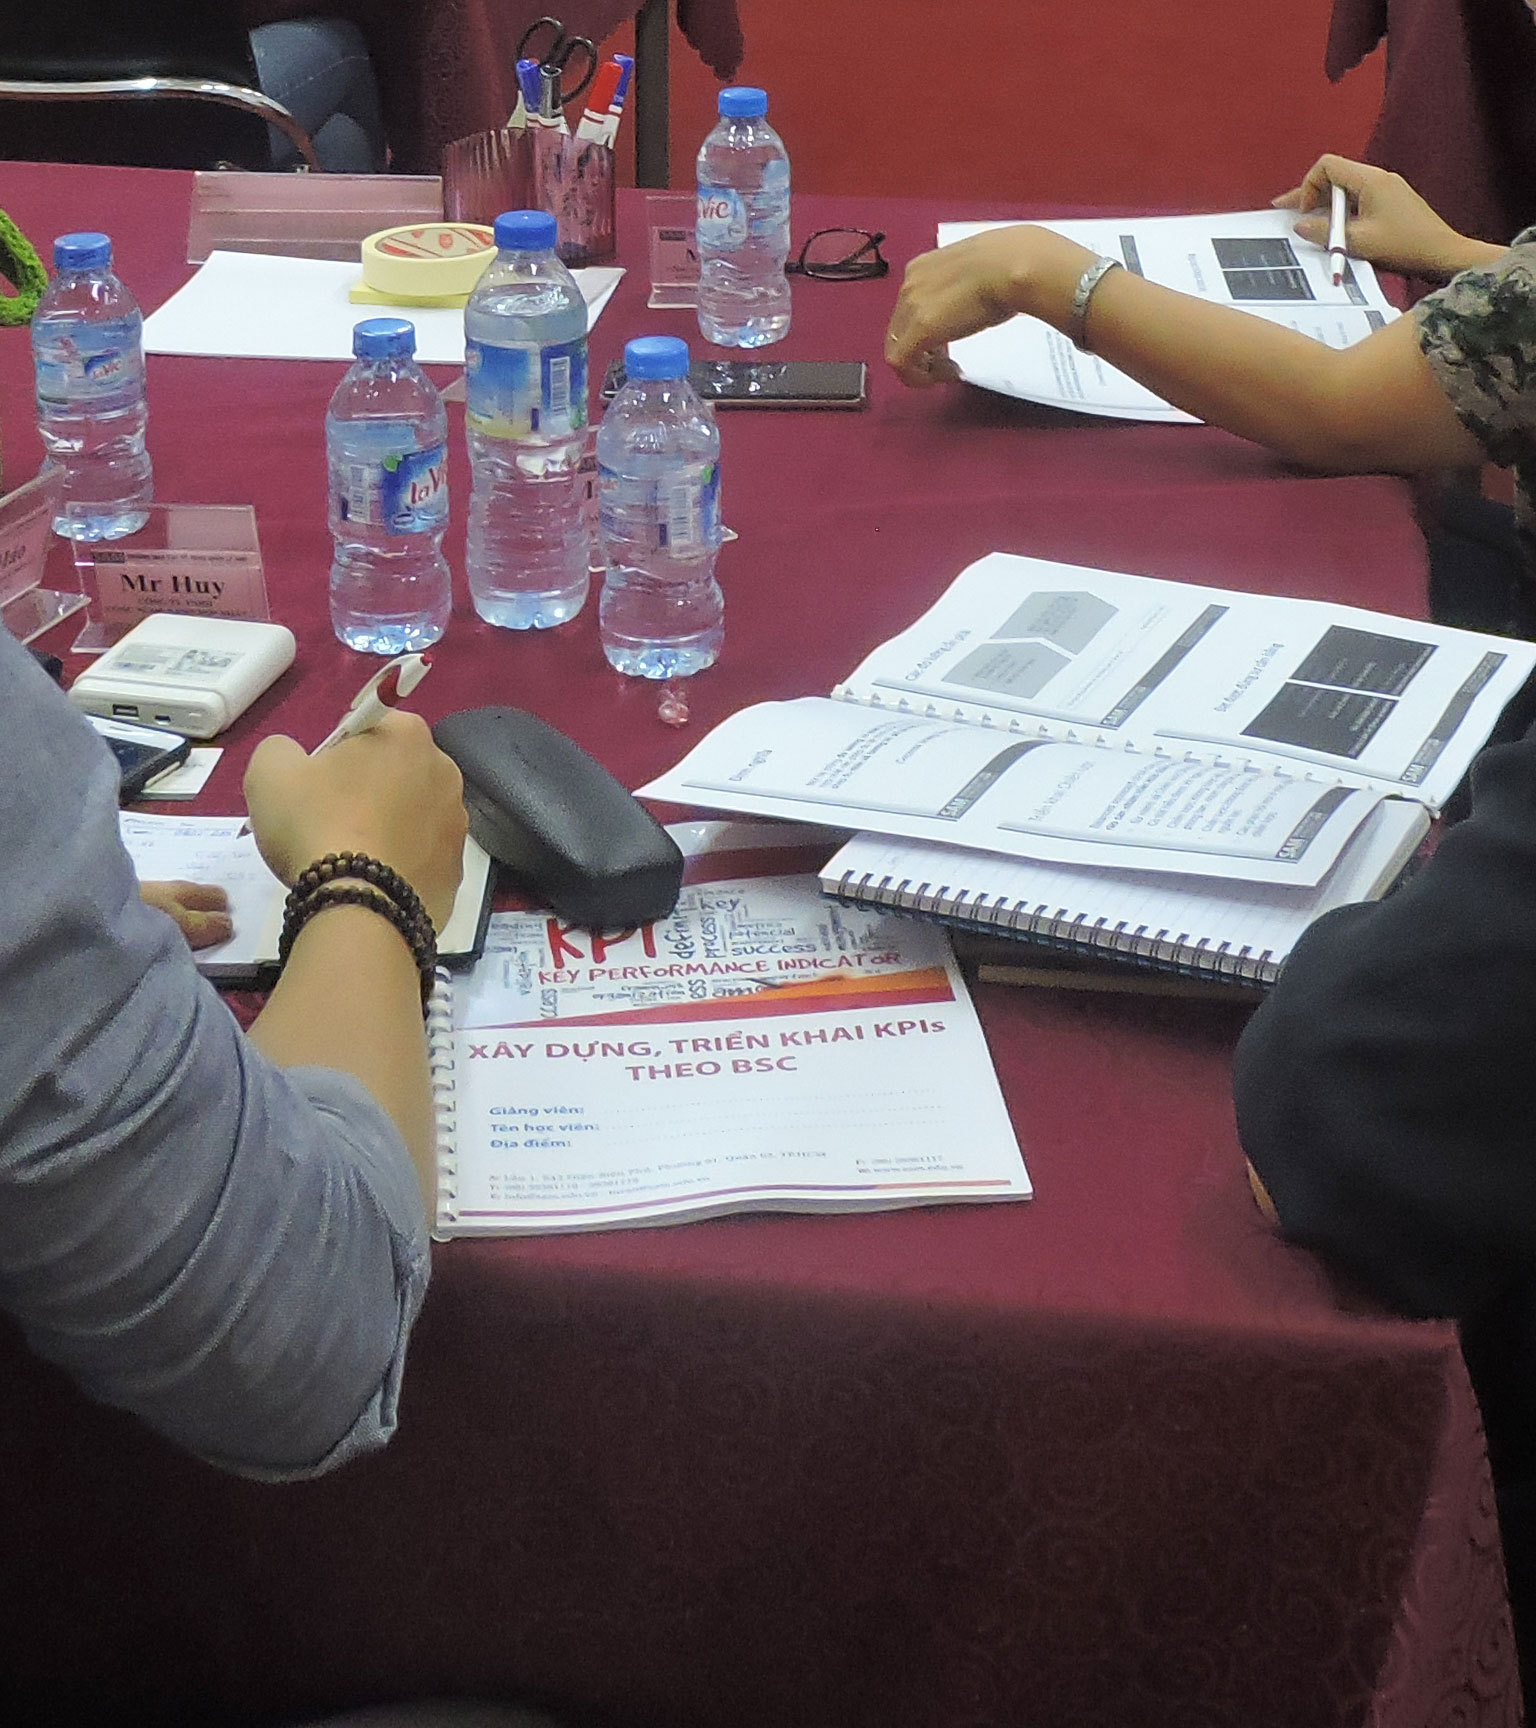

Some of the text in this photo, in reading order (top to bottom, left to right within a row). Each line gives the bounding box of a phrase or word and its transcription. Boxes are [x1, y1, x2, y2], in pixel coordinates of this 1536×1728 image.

[121, 573, 226, 600] Mr Huy
[547, 918, 657, 969] KPI
[731, 943, 816, 957] success
[538, 969, 580, 985] KEY
[588, 960, 770, 982] PERFORMANCE
[777, 952, 902, 971] INDICATOR
[468, 1019, 947, 1063] XÂY DỰNG, TRIỂN KHAI KPIs
[625, 1055, 799, 1082] THEO BSC
